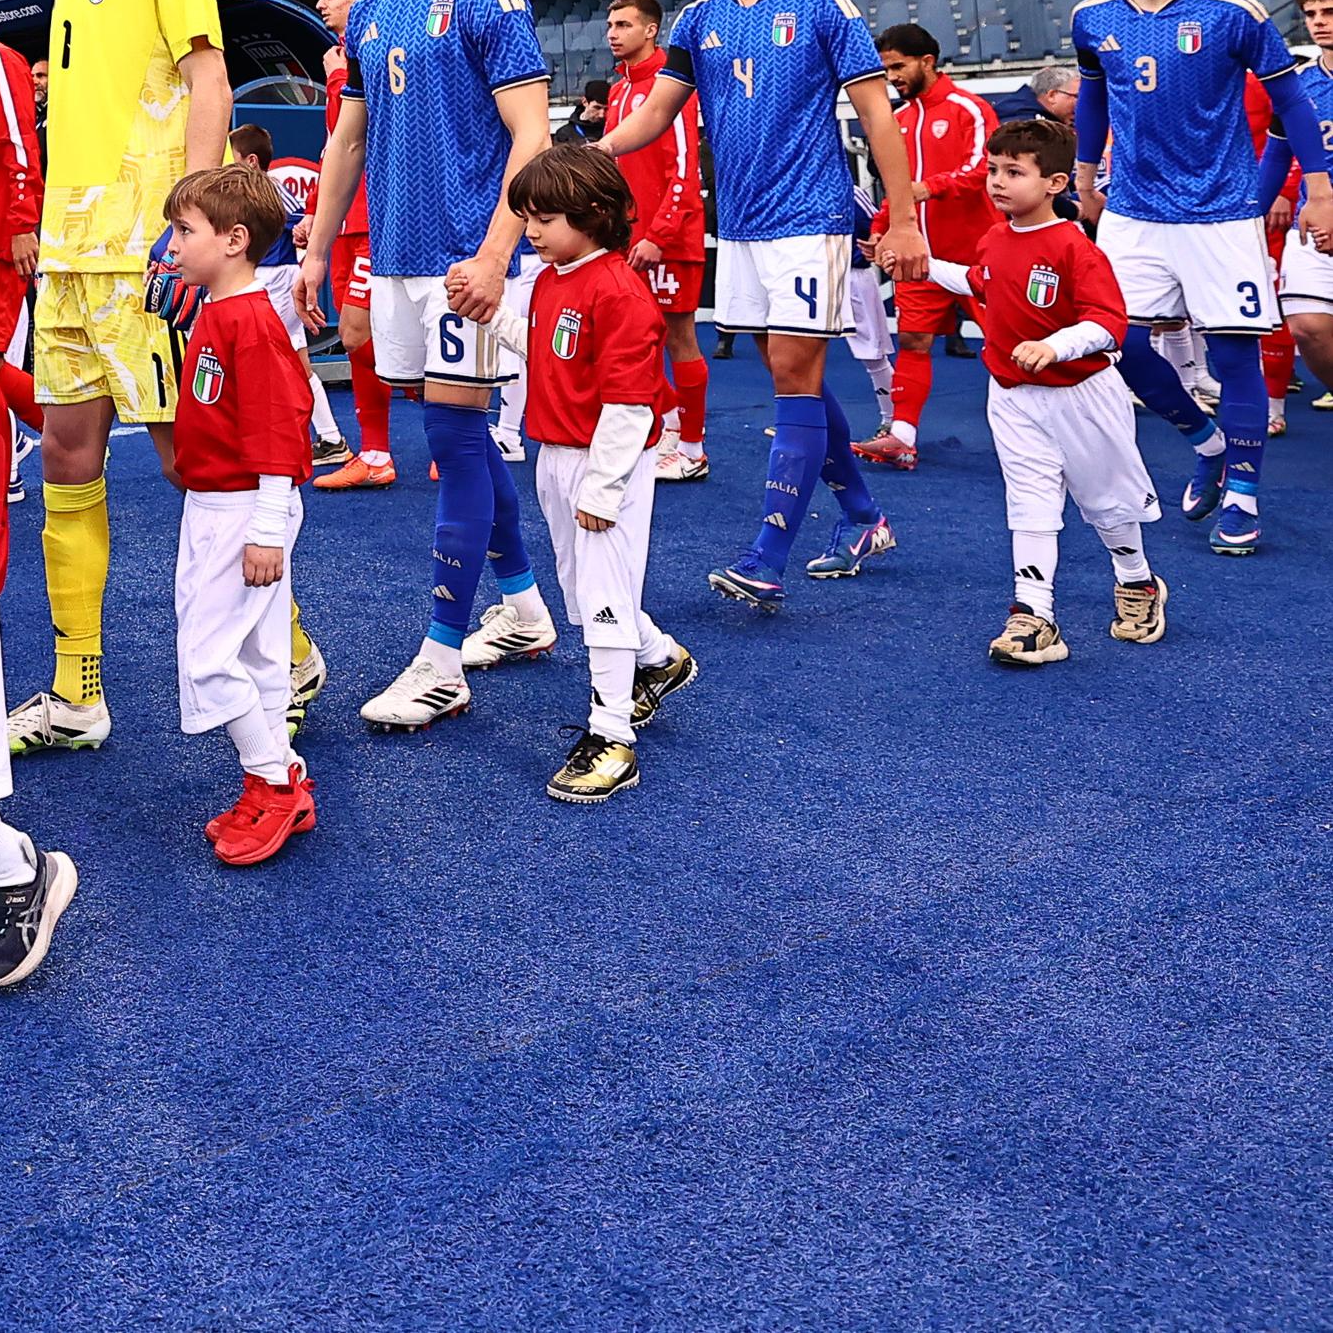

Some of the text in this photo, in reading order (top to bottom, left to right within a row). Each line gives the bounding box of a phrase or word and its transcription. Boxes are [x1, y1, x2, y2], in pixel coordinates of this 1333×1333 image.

[61, 19, 72, 69] 1
[248, 45, 288, 59] ITALIA
[388, 47, 405, 94] 6
[733, 57, 754, 98] 4
[1135, 55, 1157, 92] 3
[349, 256, 372, 292] 5
[648, 264, 680, 295] 14
[795, 276, 817, 319] 4
[1237, 281, 1261, 318] 3
[439, 312, 464, 363] 6
[151, 352, 167, 408] 1
[200, 357, 223, 373] ITALIA
